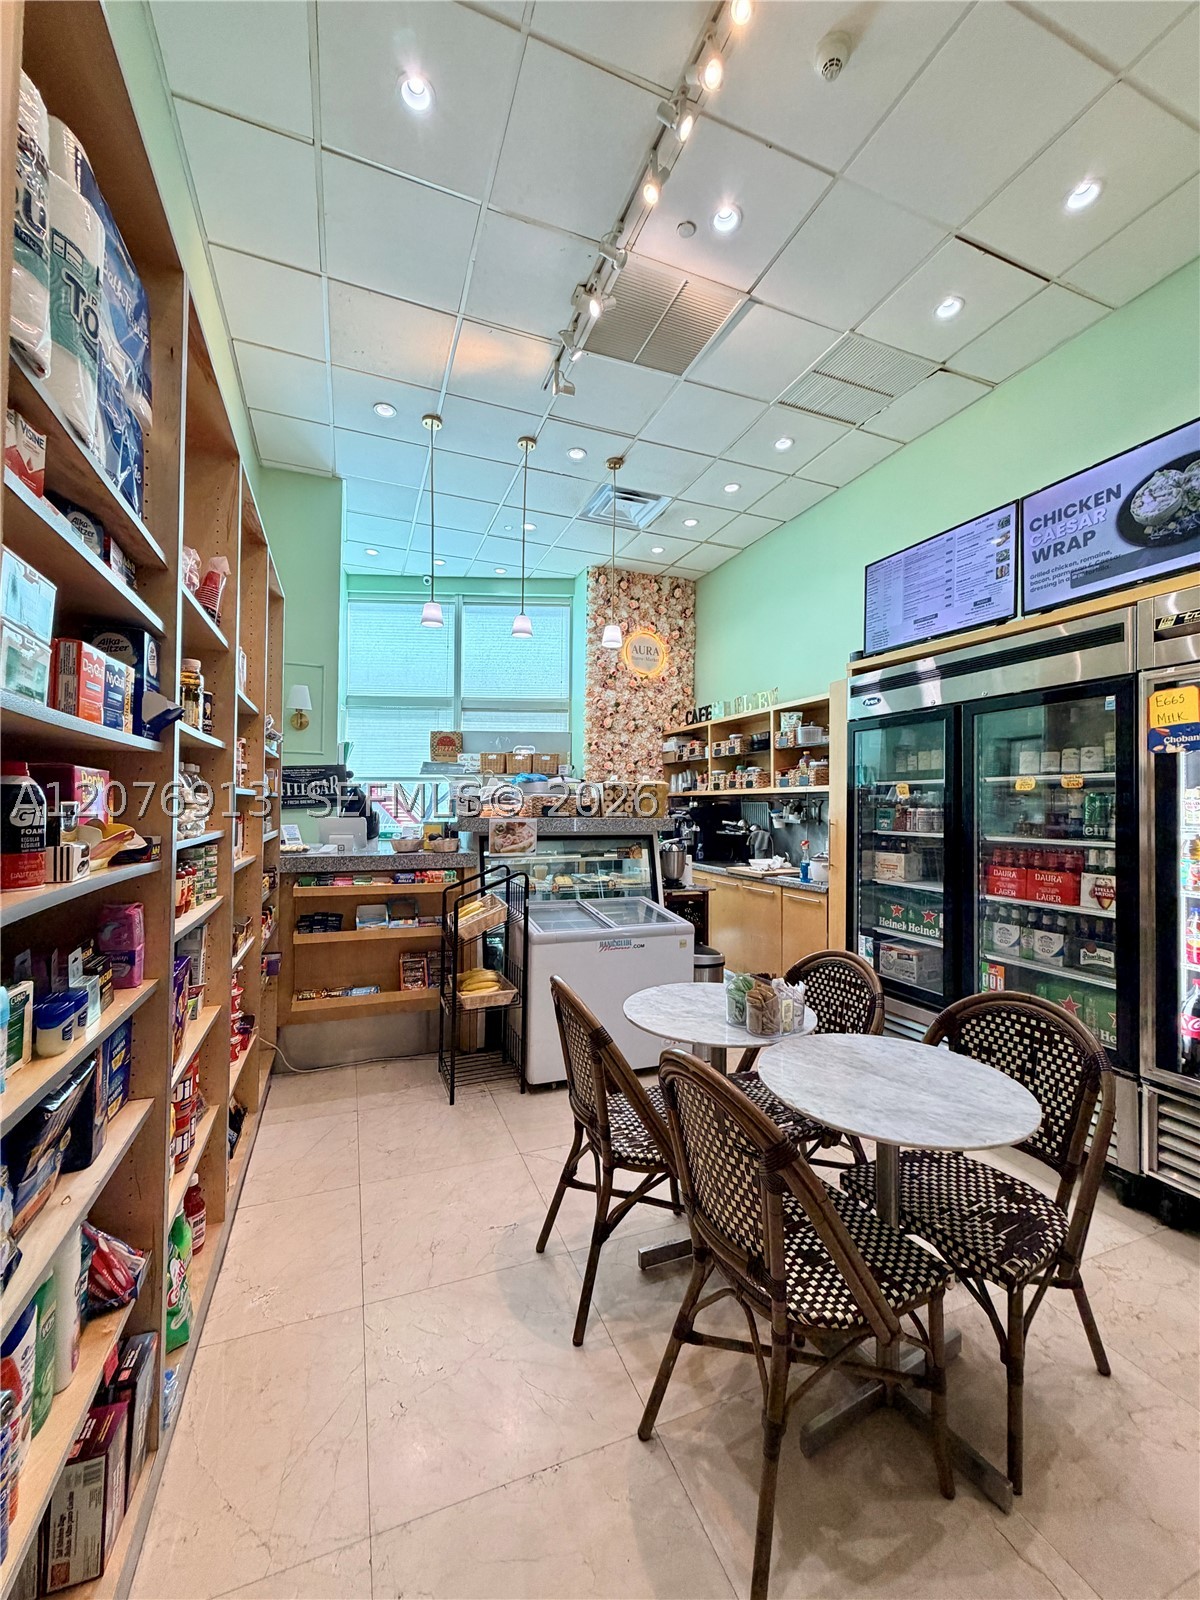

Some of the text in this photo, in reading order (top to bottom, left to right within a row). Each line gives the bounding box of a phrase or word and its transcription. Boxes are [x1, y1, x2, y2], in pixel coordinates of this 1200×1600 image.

[20, 419, 45, 450] VISINE
[1029, 483, 1122, 532] CHICKEN
[1029, 506, 1108, 547] CAESAR
[1031, 529, 1097, 565] WRAP
[1030, 550, 1112, 580] Grilled chicken, romaine,
[1030, 580, 1058, 593] dressing
[97, 637, 124, 645] Alka-
[632, 645, 660, 656] AURA
[685, 704, 712, 726] CAFE
[1157, 711, 1189, 725] MILK
[993, 869, 1017, 879] DAURA
[1034, 873, 1063, 884] DAURA
[994, 887, 1017, 897] LAGER
[1036, 892, 1062, 903] LAGER
